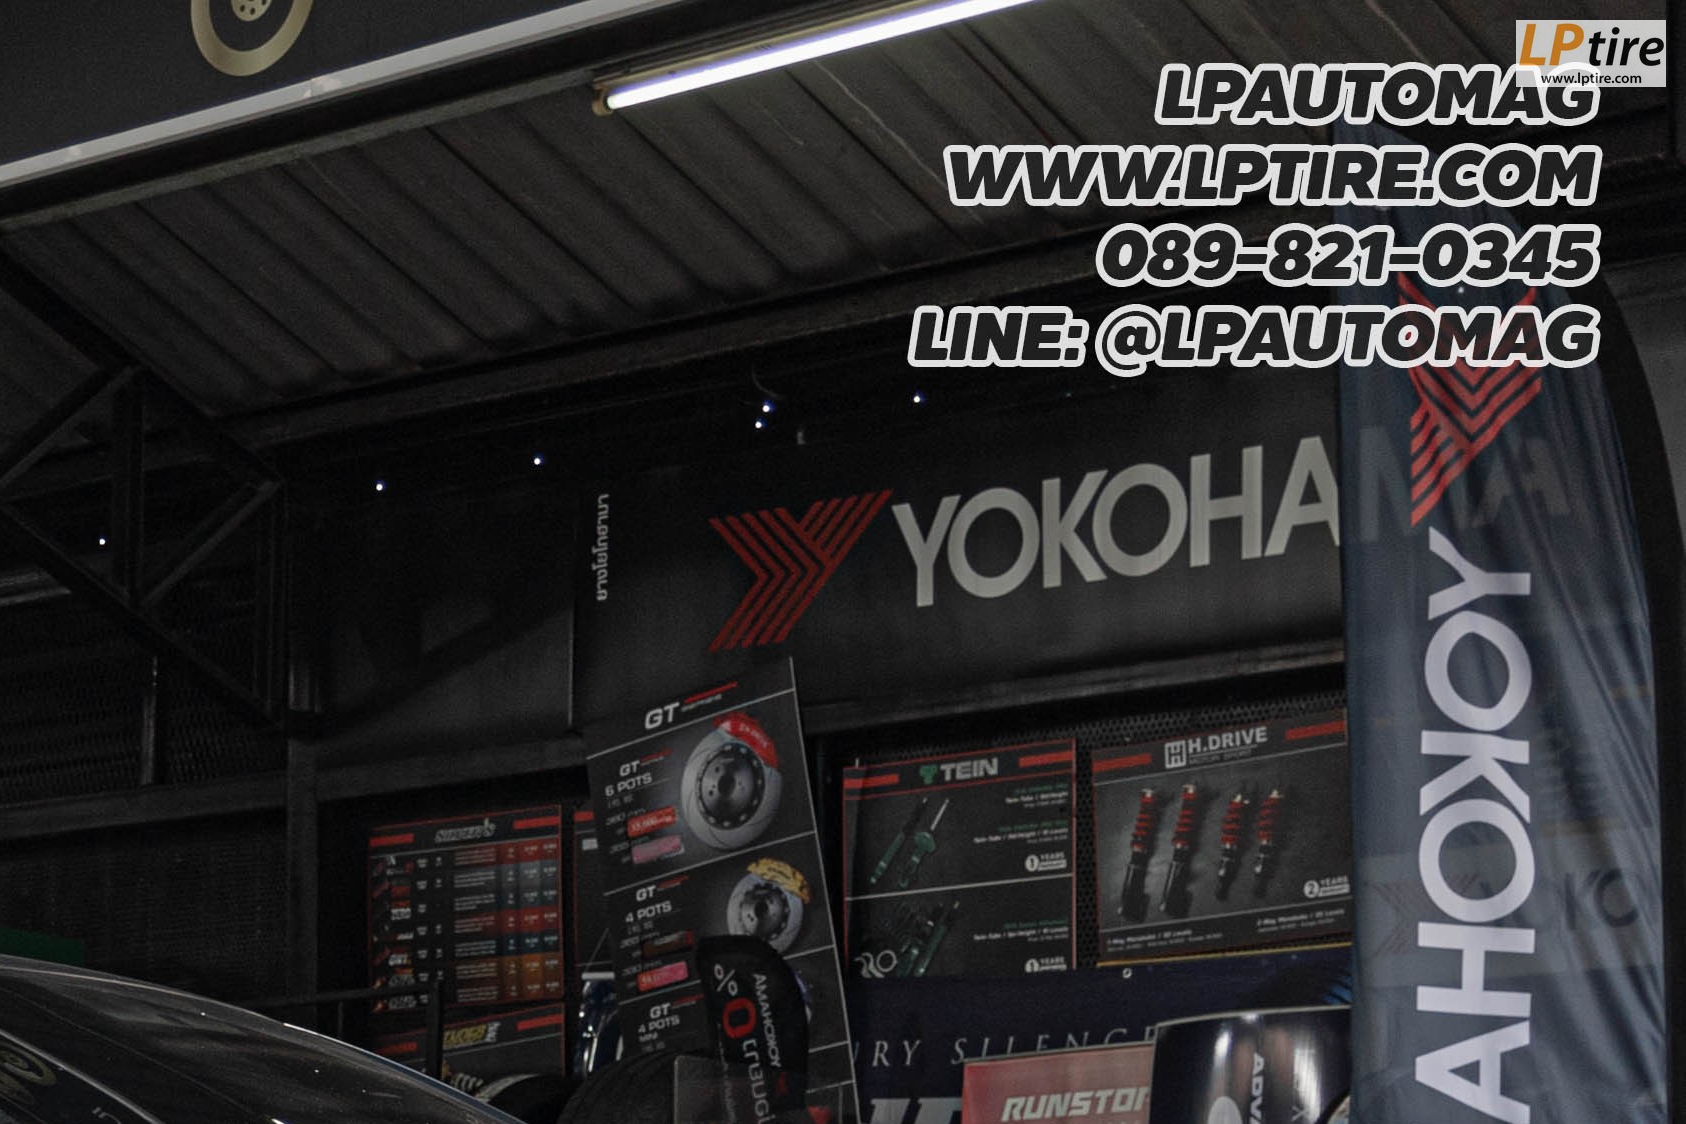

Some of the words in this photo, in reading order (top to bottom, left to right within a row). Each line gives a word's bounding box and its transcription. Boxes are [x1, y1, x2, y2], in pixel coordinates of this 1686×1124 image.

[645, 702, 681, 730] GT
[1187, 726, 1269, 755] H.DRIVE
[619, 760, 641, 777] GT
[940, 757, 999, 782] TEIN
[604, 784, 615, 797] 6
[617, 772, 653, 792] POTS
[635, 884, 657, 902] GT
[625, 912, 635, 923] 4
[637, 900, 673, 921] POTS
[648, 1014, 681, 1031] POTS
[649, 1002, 671, 1019] GT
[852, 1040, 920, 1067] RY
